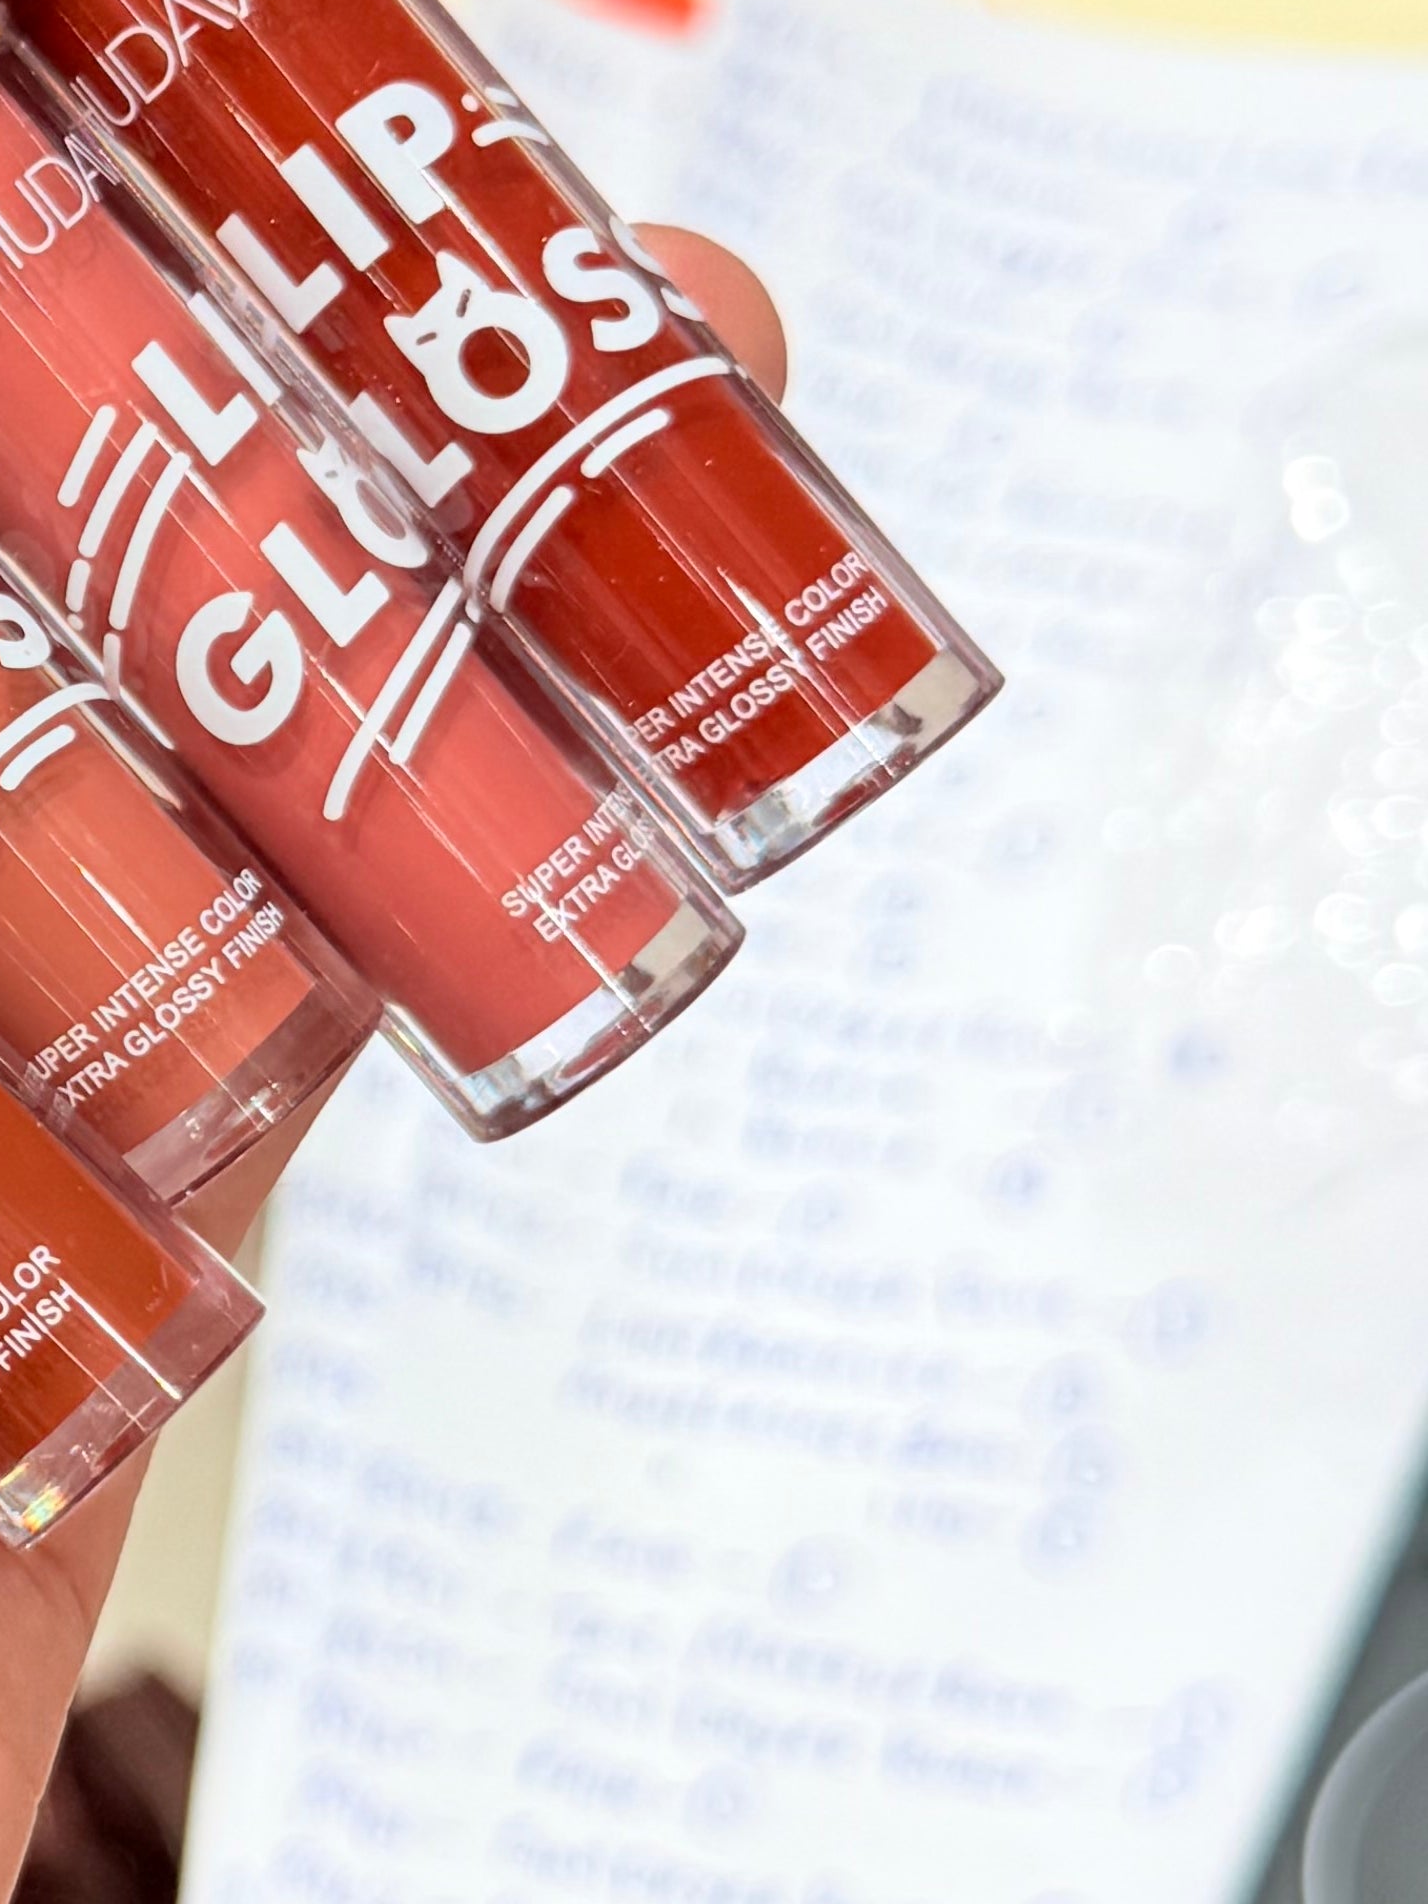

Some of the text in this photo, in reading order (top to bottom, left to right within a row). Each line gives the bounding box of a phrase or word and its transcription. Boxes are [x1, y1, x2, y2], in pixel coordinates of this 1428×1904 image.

[215, 80, 454, 335] LIP
[697, 649, 810, 745] GLOSSY
[804, 585, 889, 662] FINISH
[783, 550, 870, 628] COLOR
[90, 925, 207, 1033] INTENSE
[198, 867, 263, 936] COLOR
[500, 834, 592, 918] SUPER
[532, 863, 621, 943] EXTRA
[55, 900, 285, 1108] XTRA GLOSSY FINISH
